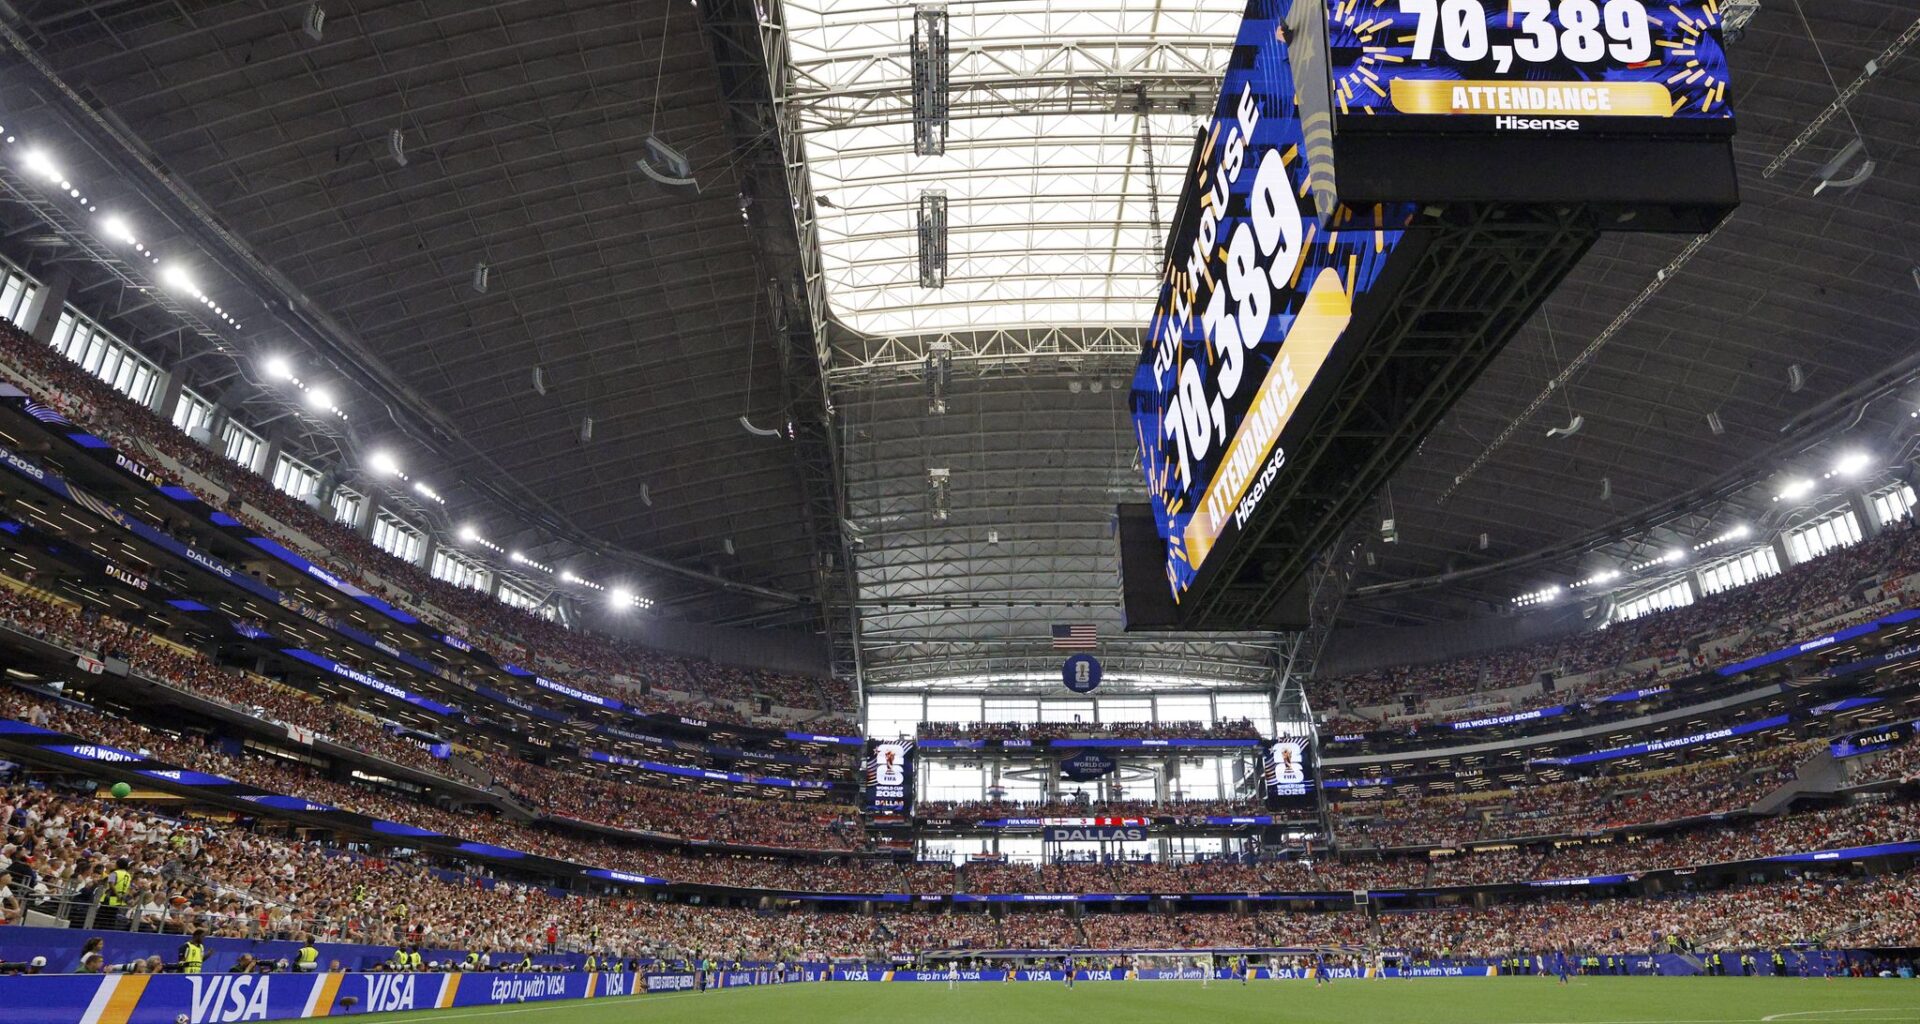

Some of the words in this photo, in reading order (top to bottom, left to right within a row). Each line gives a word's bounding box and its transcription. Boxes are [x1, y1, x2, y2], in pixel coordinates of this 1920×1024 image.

[1400, 0, 1651, 73] 70,389
[1452, 86, 1611, 111] ATTENDANCE
[1496, 116, 1579, 130] Hisense
[1153, 292, 1191, 393] FULL
[1187, 81, 1260, 292] HOUSE
[1164, 149, 1303, 493] 70,389
[1207, 353, 1299, 532] ATTENDANCE
[8, 455, 44, 479] 2026
[116, 453, 163, 487] DALLAS
[1235, 448, 1285, 531] Hisense
[186, 549, 232, 577] DALLAS
[105, 564, 149, 591] DALLAS
[445, 635, 471, 653] DALLAS
[334, 664, 348, 676] FIFA
[349, 670, 372, 685] WORLD
[372, 680, 384, 690] CUP
[384, 685, 405, 698] 2026
[536, 677, 549, 688] FIFA
[550, 681, 570, 694] WORLD
[571, 689, 582, 698] CUP
[1638, 684, 1670, 697] DALLAS
[507, 697, 533, 711] DALLAS
[680, 717, 708, 727] DALLAS
[1454, 722, 1470, 730] FIFA
[1472, 718, 1498, 728] WORLD
[1499, 715, 1514, 723] CUP
[1514, 711, 1541, 720] 2026
[1647, 743, 1664, 751] FIFA
[1664, 738, 1689, 748] WORLD
[1690, 735, 1705, 743] CUP
[1705, 729, 1732, 739] 2026
[1860, 731, 1899, 747] DALLAS
[743, 751, 775, 759] DALLAS
[1455, 770, 1483, 778] DALLAS
[1054, 830, 1141, 840] DALLAS
[843, 970, 868, 981] VISA
[917, 972, 931, 982] tap
[932, 971, 940, 980] in
[961, 972, 980, 980] VISA
[1026, 970, 1051, 980] VISA
[1086, 970, 1112, 980] VISA
[1326, 968, 1352, 978] VISA
[1413, 967, 1422, 976] in
[1424, 967, 1442, 976] with
[1443, 967, 1463, 975] VISA
[364, 974, 414, 1012] VISA
[491, 976, 511, 1004] tap
[511, 975, 522, 998] in
[524, 974, 546, 998] with
[546, 975, 566, 995] VISA
[605, 973, 624, 995] VISA
[185, 975, 270, 1023] VISA
